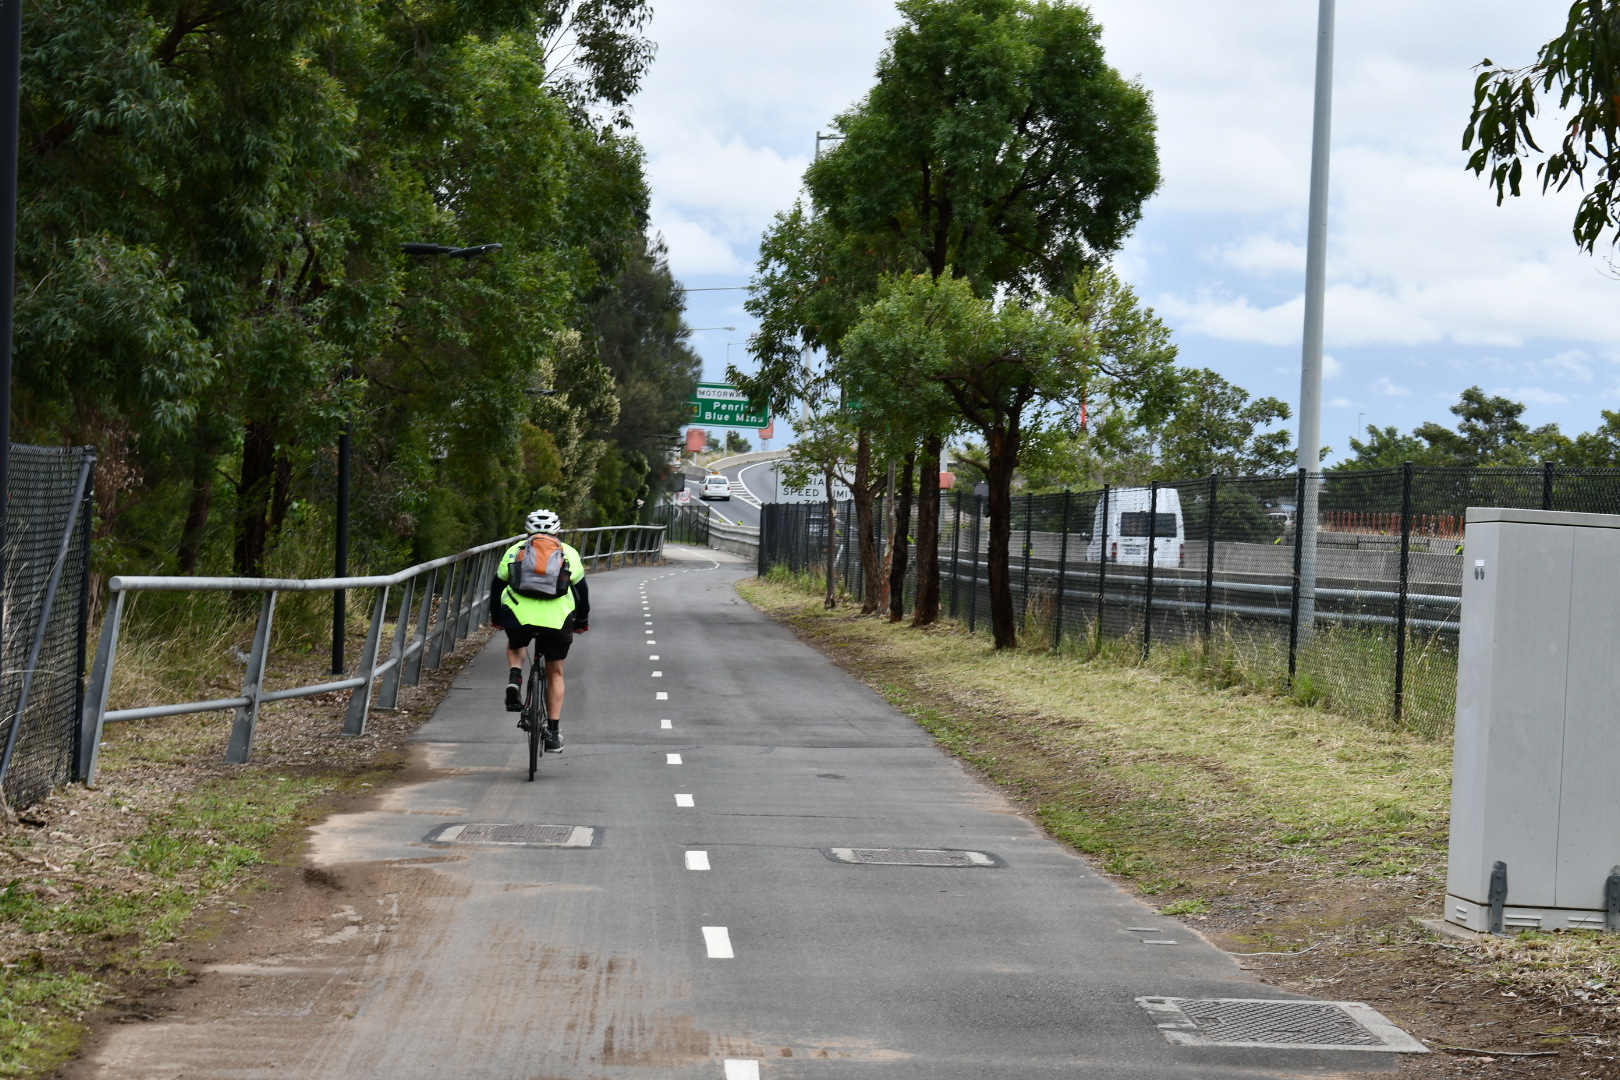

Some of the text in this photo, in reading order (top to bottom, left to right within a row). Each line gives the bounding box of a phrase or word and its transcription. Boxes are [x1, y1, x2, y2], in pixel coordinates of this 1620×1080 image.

[713, 401, 756, 412] Penri
[704, 411, 764, 423] Blue Mtns
[782, 487, 820, 497] SPEED
